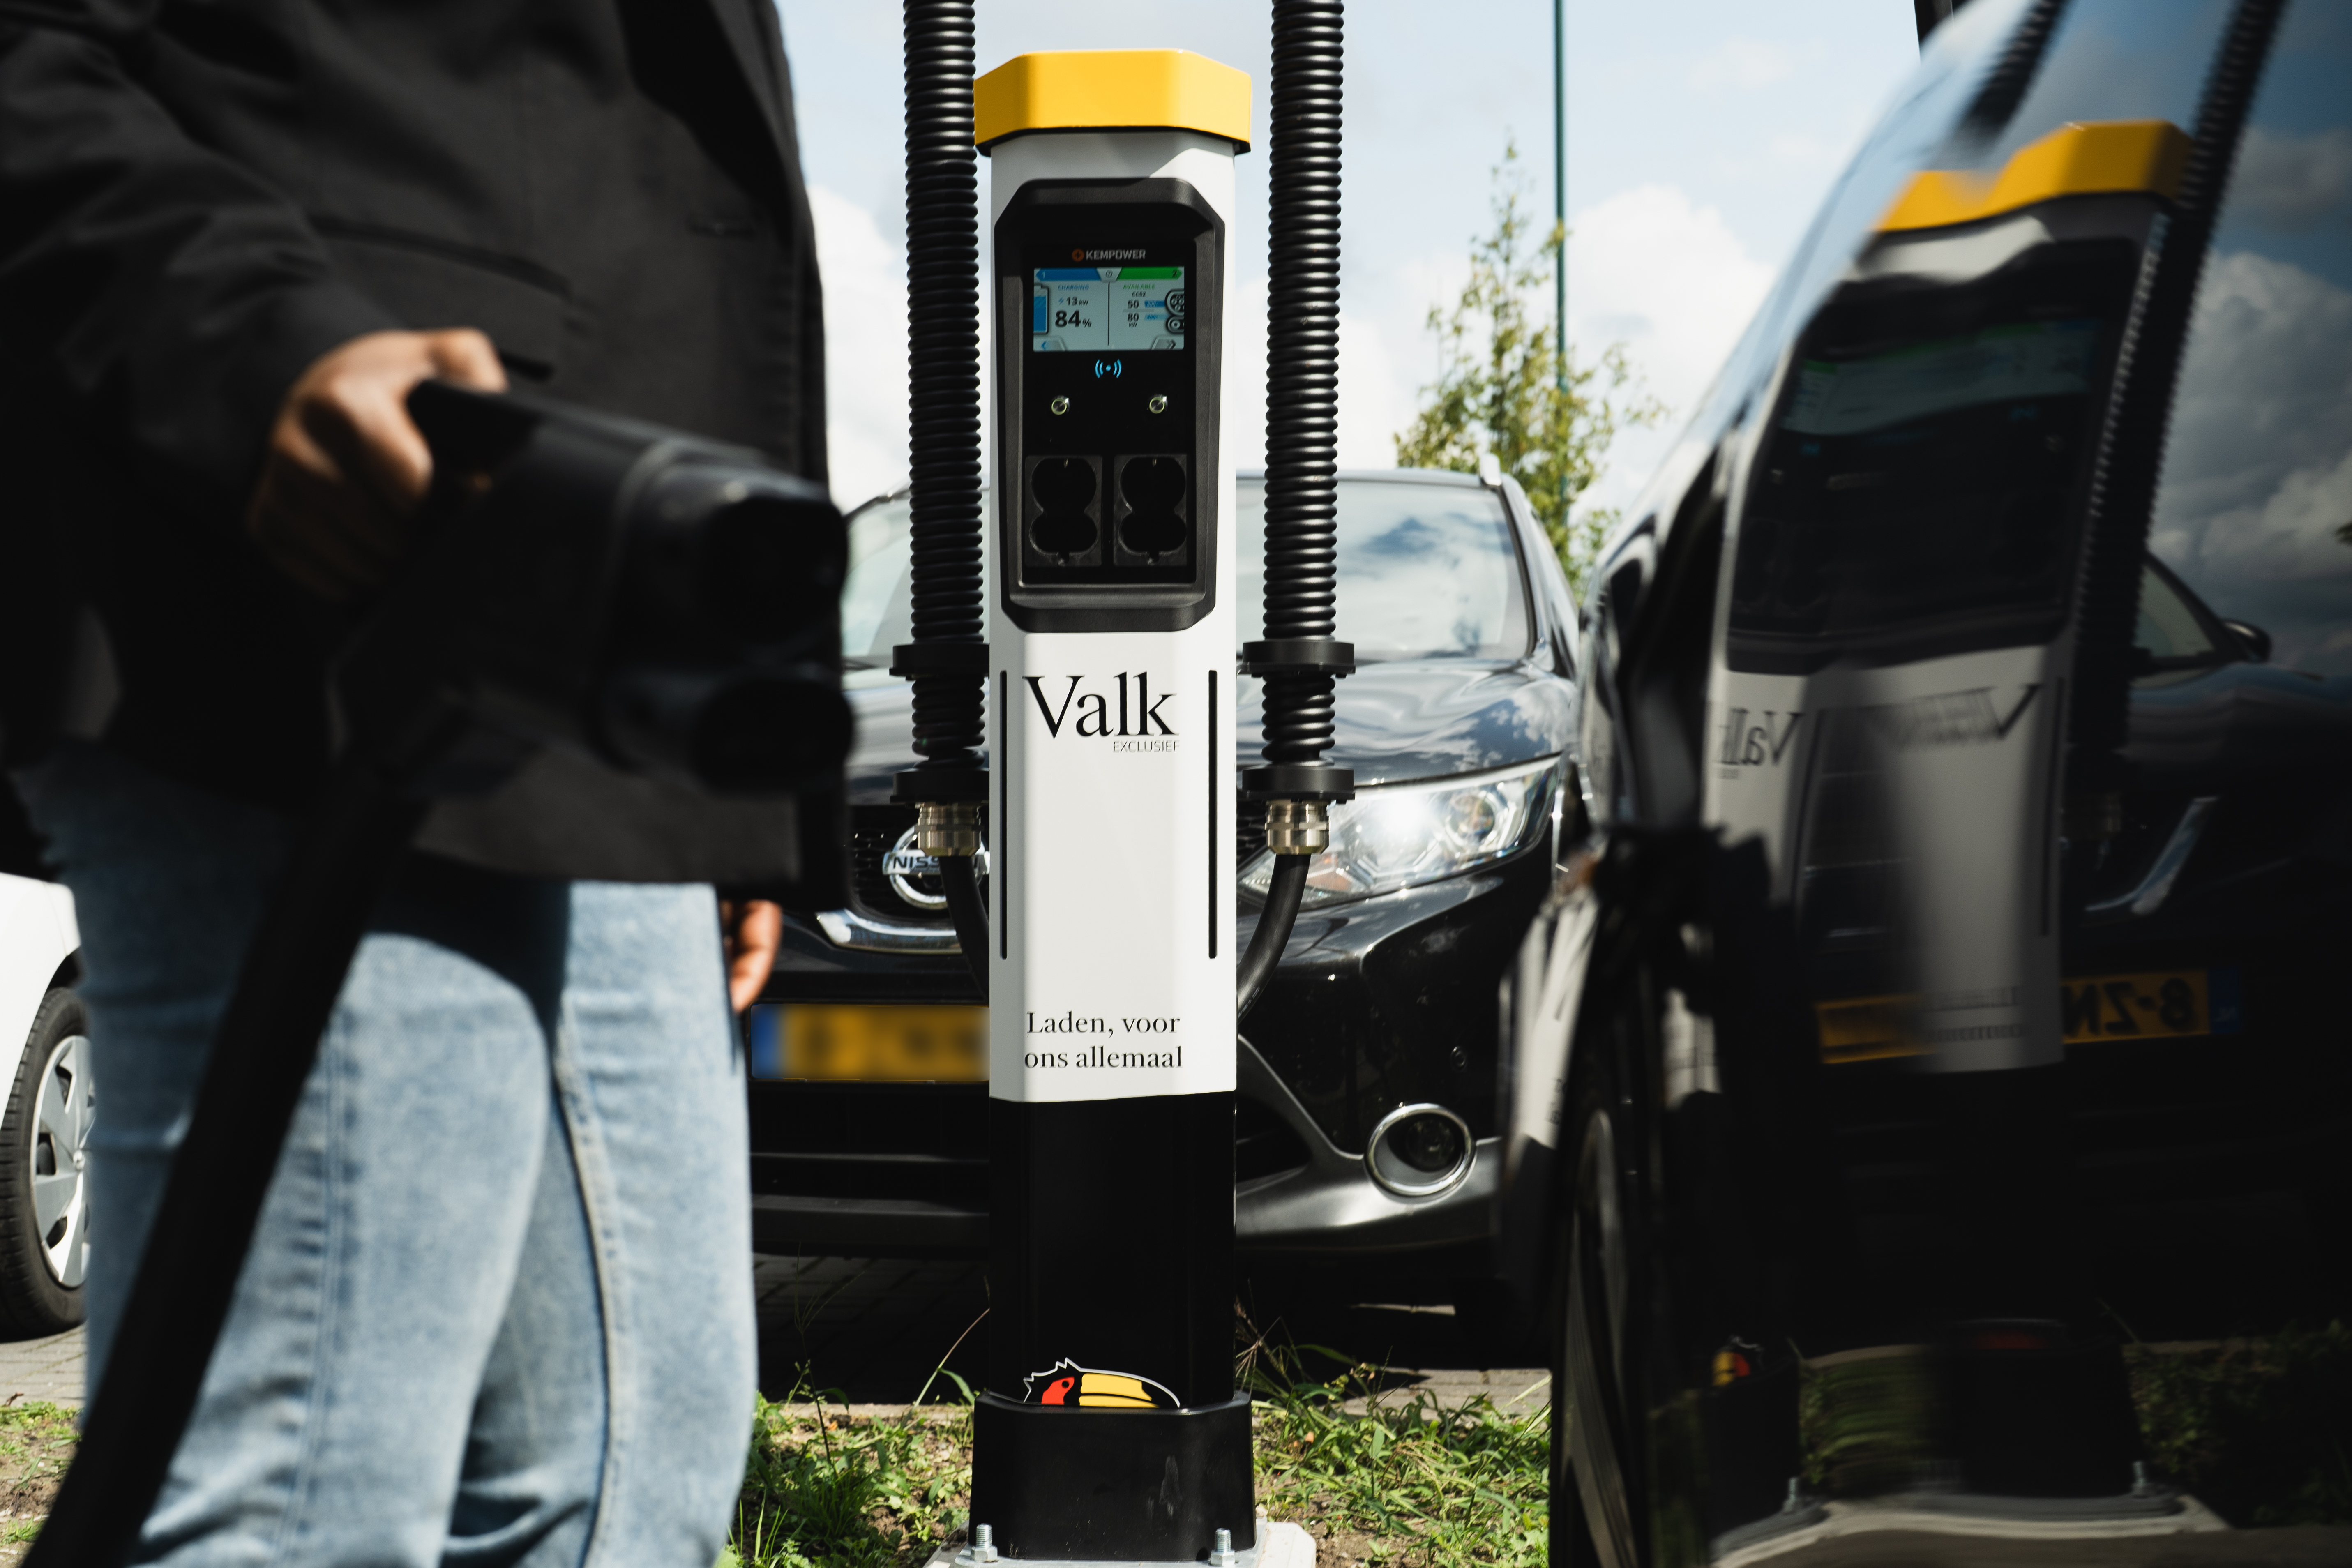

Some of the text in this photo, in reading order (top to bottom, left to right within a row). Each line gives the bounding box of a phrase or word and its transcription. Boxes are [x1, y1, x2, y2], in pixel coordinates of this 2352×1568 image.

[1086, 249, 1146, 260] KEMPOWER
[1041, 270, 1045, 279] 1
[1172, 269, 1177, 278] 2
[1022, 671, 1180, 739] Valk
[1113, 740, 1180, 753] EXCLUSIEF
[1026, 1010, 1181, 1038] Laden, voor
[1024, 1044, 1183, 1068] ons allemaal
